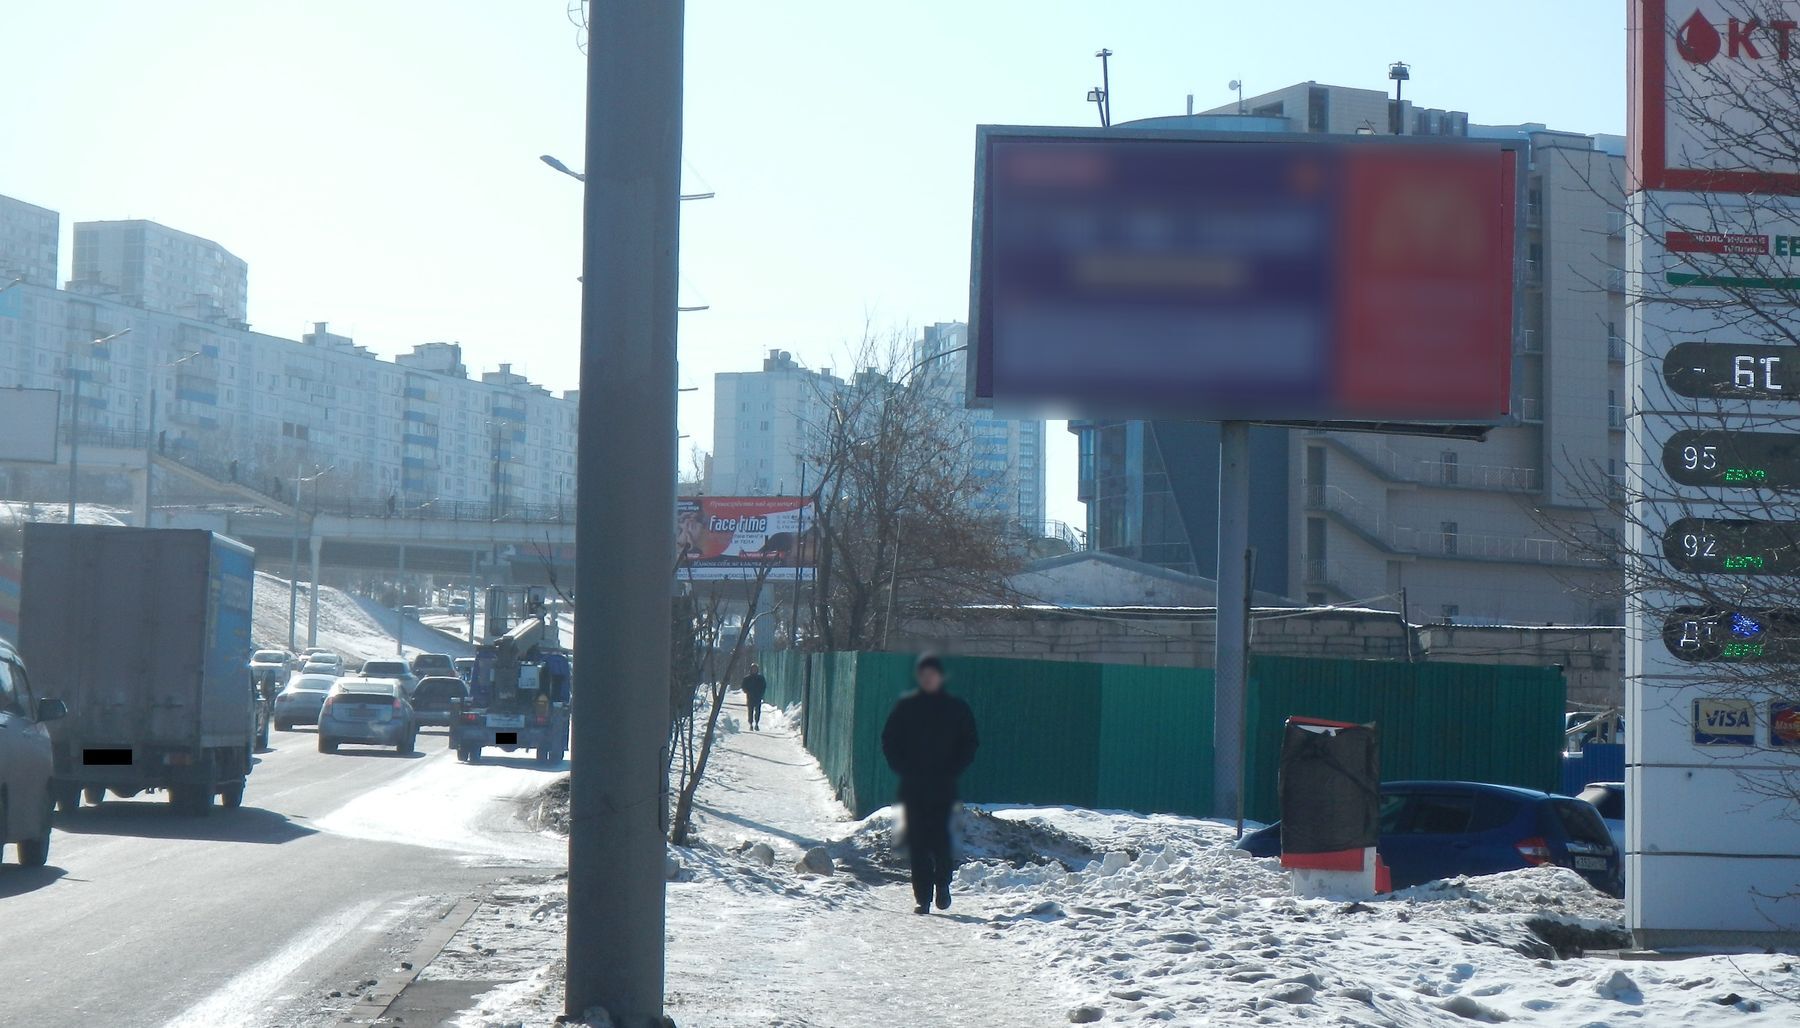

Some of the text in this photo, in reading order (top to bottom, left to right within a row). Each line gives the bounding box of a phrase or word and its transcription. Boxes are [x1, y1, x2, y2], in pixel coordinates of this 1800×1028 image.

[1684, 446, 1717, 470] 95
[1684, 534, 1716, 557] 92
[1706, 709, 1750, 727] VISA
